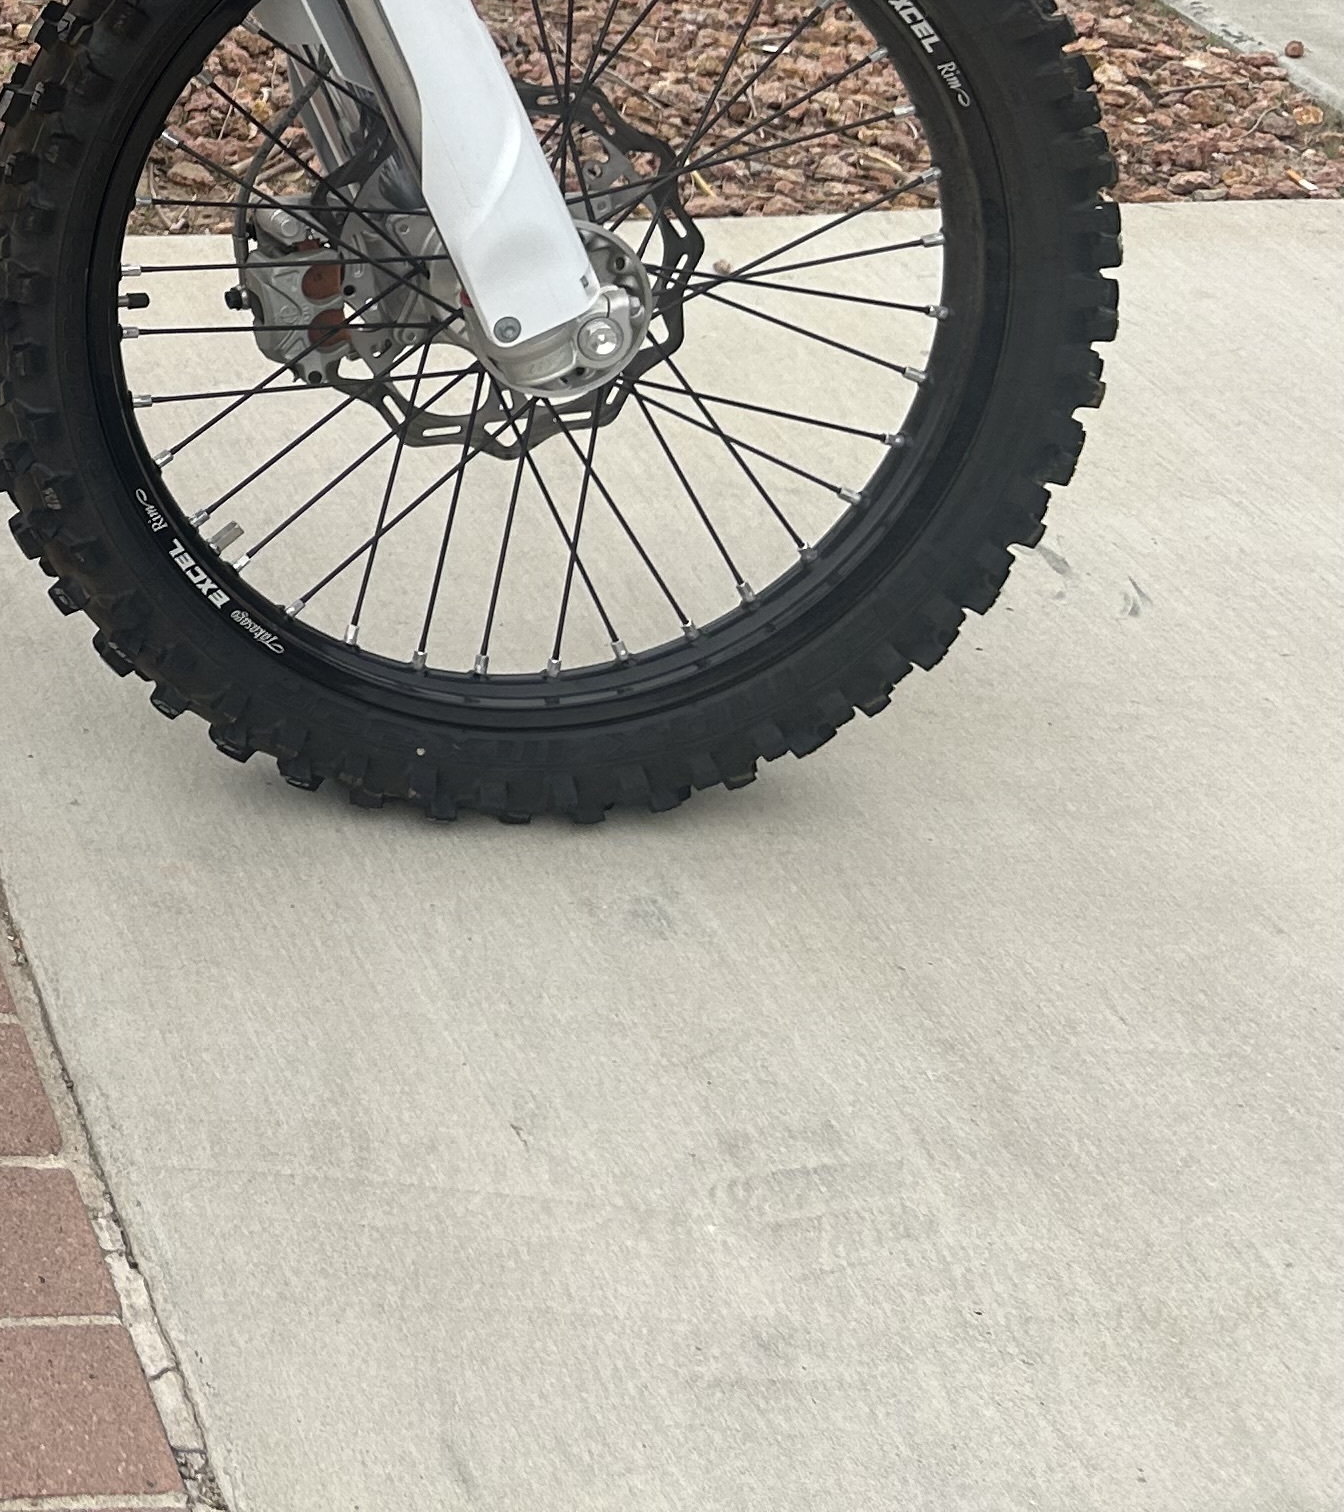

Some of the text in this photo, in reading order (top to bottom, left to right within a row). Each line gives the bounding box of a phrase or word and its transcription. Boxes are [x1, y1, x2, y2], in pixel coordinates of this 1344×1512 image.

[936, 60, 971, 108] Rim
[135, 488, 169, 533] Rim
[167, 538, 231, 609] EXCEL
